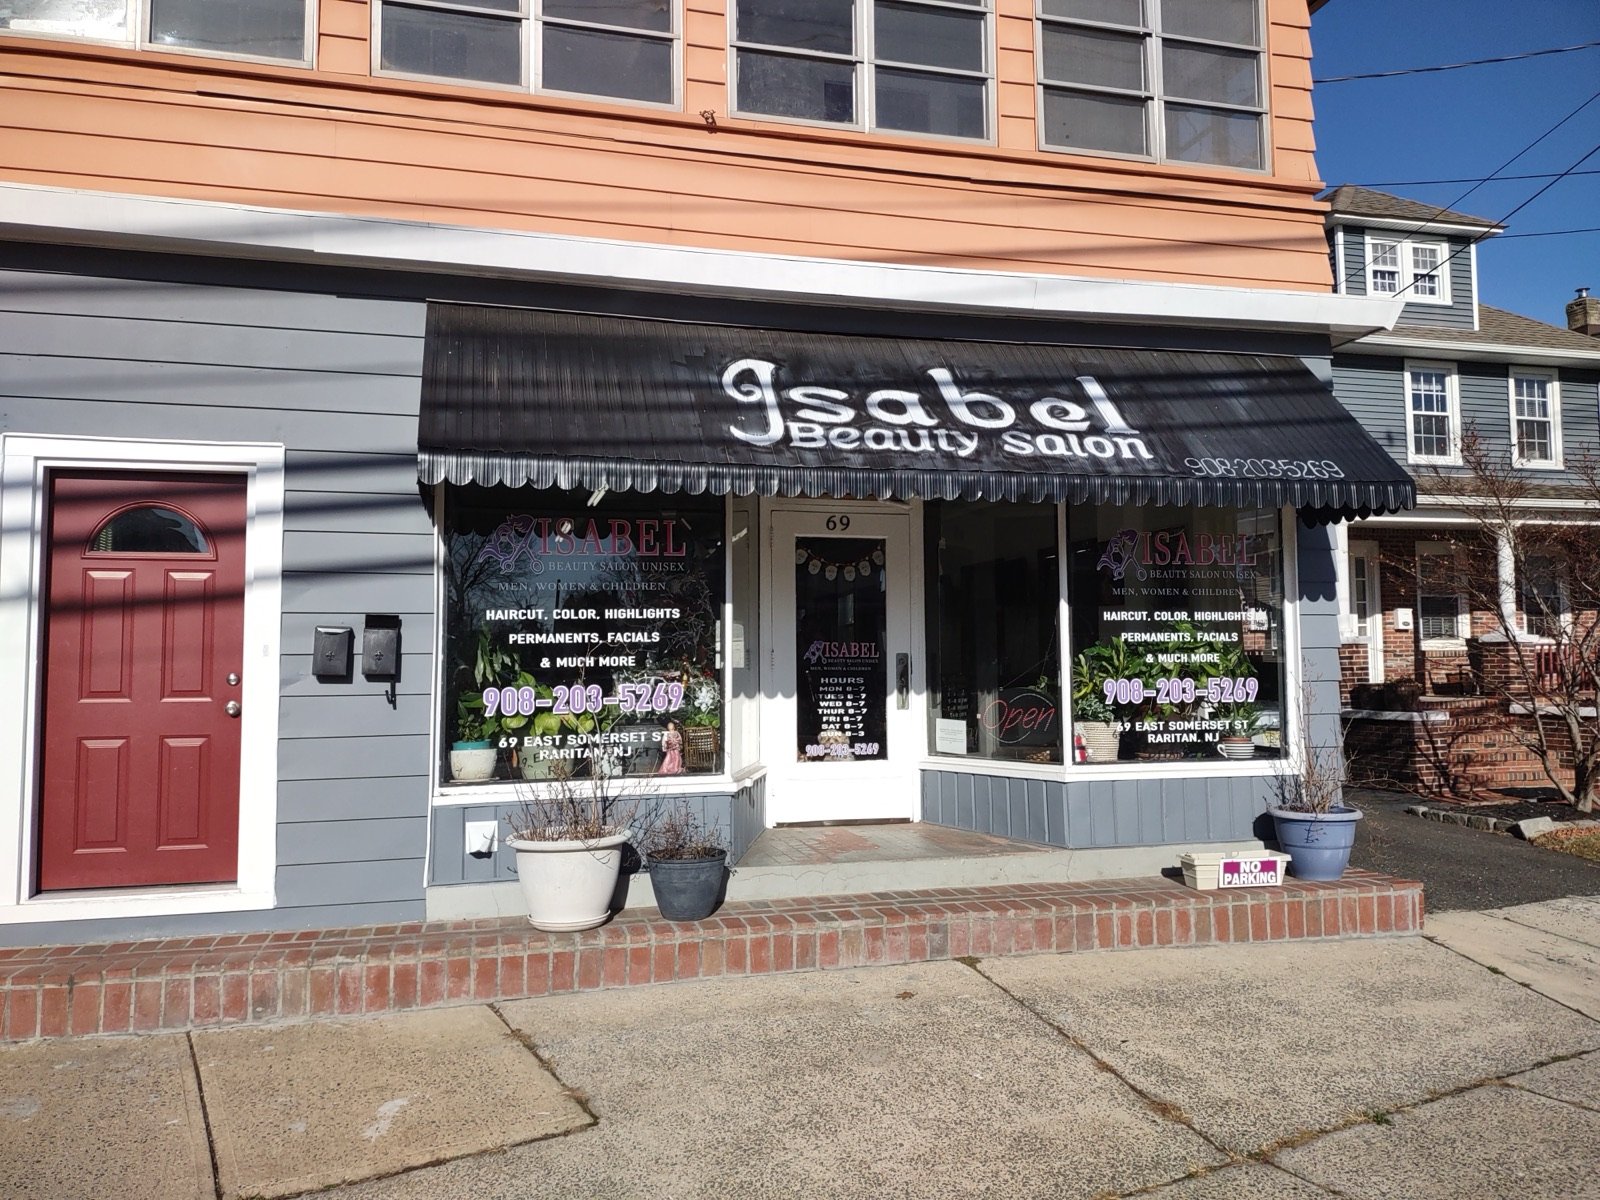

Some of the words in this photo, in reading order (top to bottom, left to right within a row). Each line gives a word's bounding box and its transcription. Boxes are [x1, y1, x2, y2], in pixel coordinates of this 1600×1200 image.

[722, 357, 1140, 447] Isabel
[790, 422, 981, 458] Beauty
[825, 515, 851, 531] 69
[538, 519, 686, 557] ISABEL
[1140, 531, 1257, 566] ISABEL
[548, 562, 597, 571] BEAUTY
[600, 562, 638, 571] SALON
[642, 562, 685, 572] UNISEX
[1150, 569, 1187, 579] BEAUTY
[1189, 570, 1220, 579] SALON
[1222, 570, 1257, 579] UNISEX
[498, 582, 532, 592] MEN,
[536, 582, 586, 591] WOMEN
[589, 582, 598, 591] &
[602, 582, 667, 591] CHILDREN
[1112, 588, 1139, 597] MEN,
[1141, 588, 1180, 596] WOMEN
[1182, 588, 1189, 596] &
[1192, 588, 1242, 597] CHILDREN
[486, 609, 548, 621] HAIRCUT,
[553, 609, 600, 621] COLOR,
[605, 608, 681, 619] HIGHLIGHTS
[1103, 611, 1151, 622] HAIRCUT,
[1154, 611, 1191, 622] COLOR,
[1194, 611, 1254, 621] HIGHLIGHTS
[509, 633, 603, 645] PERMANENTS,
[607, 632, 660, 643] FACIALS
[1121, 633, 1194, 643] PERMANENTS,
[1197, 632, 1238, 642] FACIALS
[824, 642, 880, 658] ISABEL
[540, 657, 551, 669] &
[556, 657, 596, 668] MUCH
[599, 656, 636, 667] MORE
[1146, 653, 1153, 664] &
[1158, 654, 1189, 663] MUCH
[1191, 653, 1220, 663] MORE
[1103, 677, 1258, 705] 908-203-5269
[482, 683, 684, 717] 908-203-5269
[983, 700, 1056, 738] Open
[1116, 721, 1131, 732] 69
[1136, 721, 1164, 732] EAST
[1169, 720, 1231, 731] SOMERSET
[1234, 720, 1249, 730] ST
[498, 737, 518, 748] 69
[524, 735, 562, 747] EAST
[567, 732, 648, 746] SOMERSET
[652, 731, 670, 743] ST
[1147, 732, 1202, 743] RARITAN,
[1204, 732, 1220, 743] NJ
[539, 748, 606, 761] RARITAN
[613, 746, 633, 758] NJ
[805, 742, 880, 757] 908-203-5269
[1240, 861, 1262, 873] NO
[1224, 872, 1276, 885] PARKING
